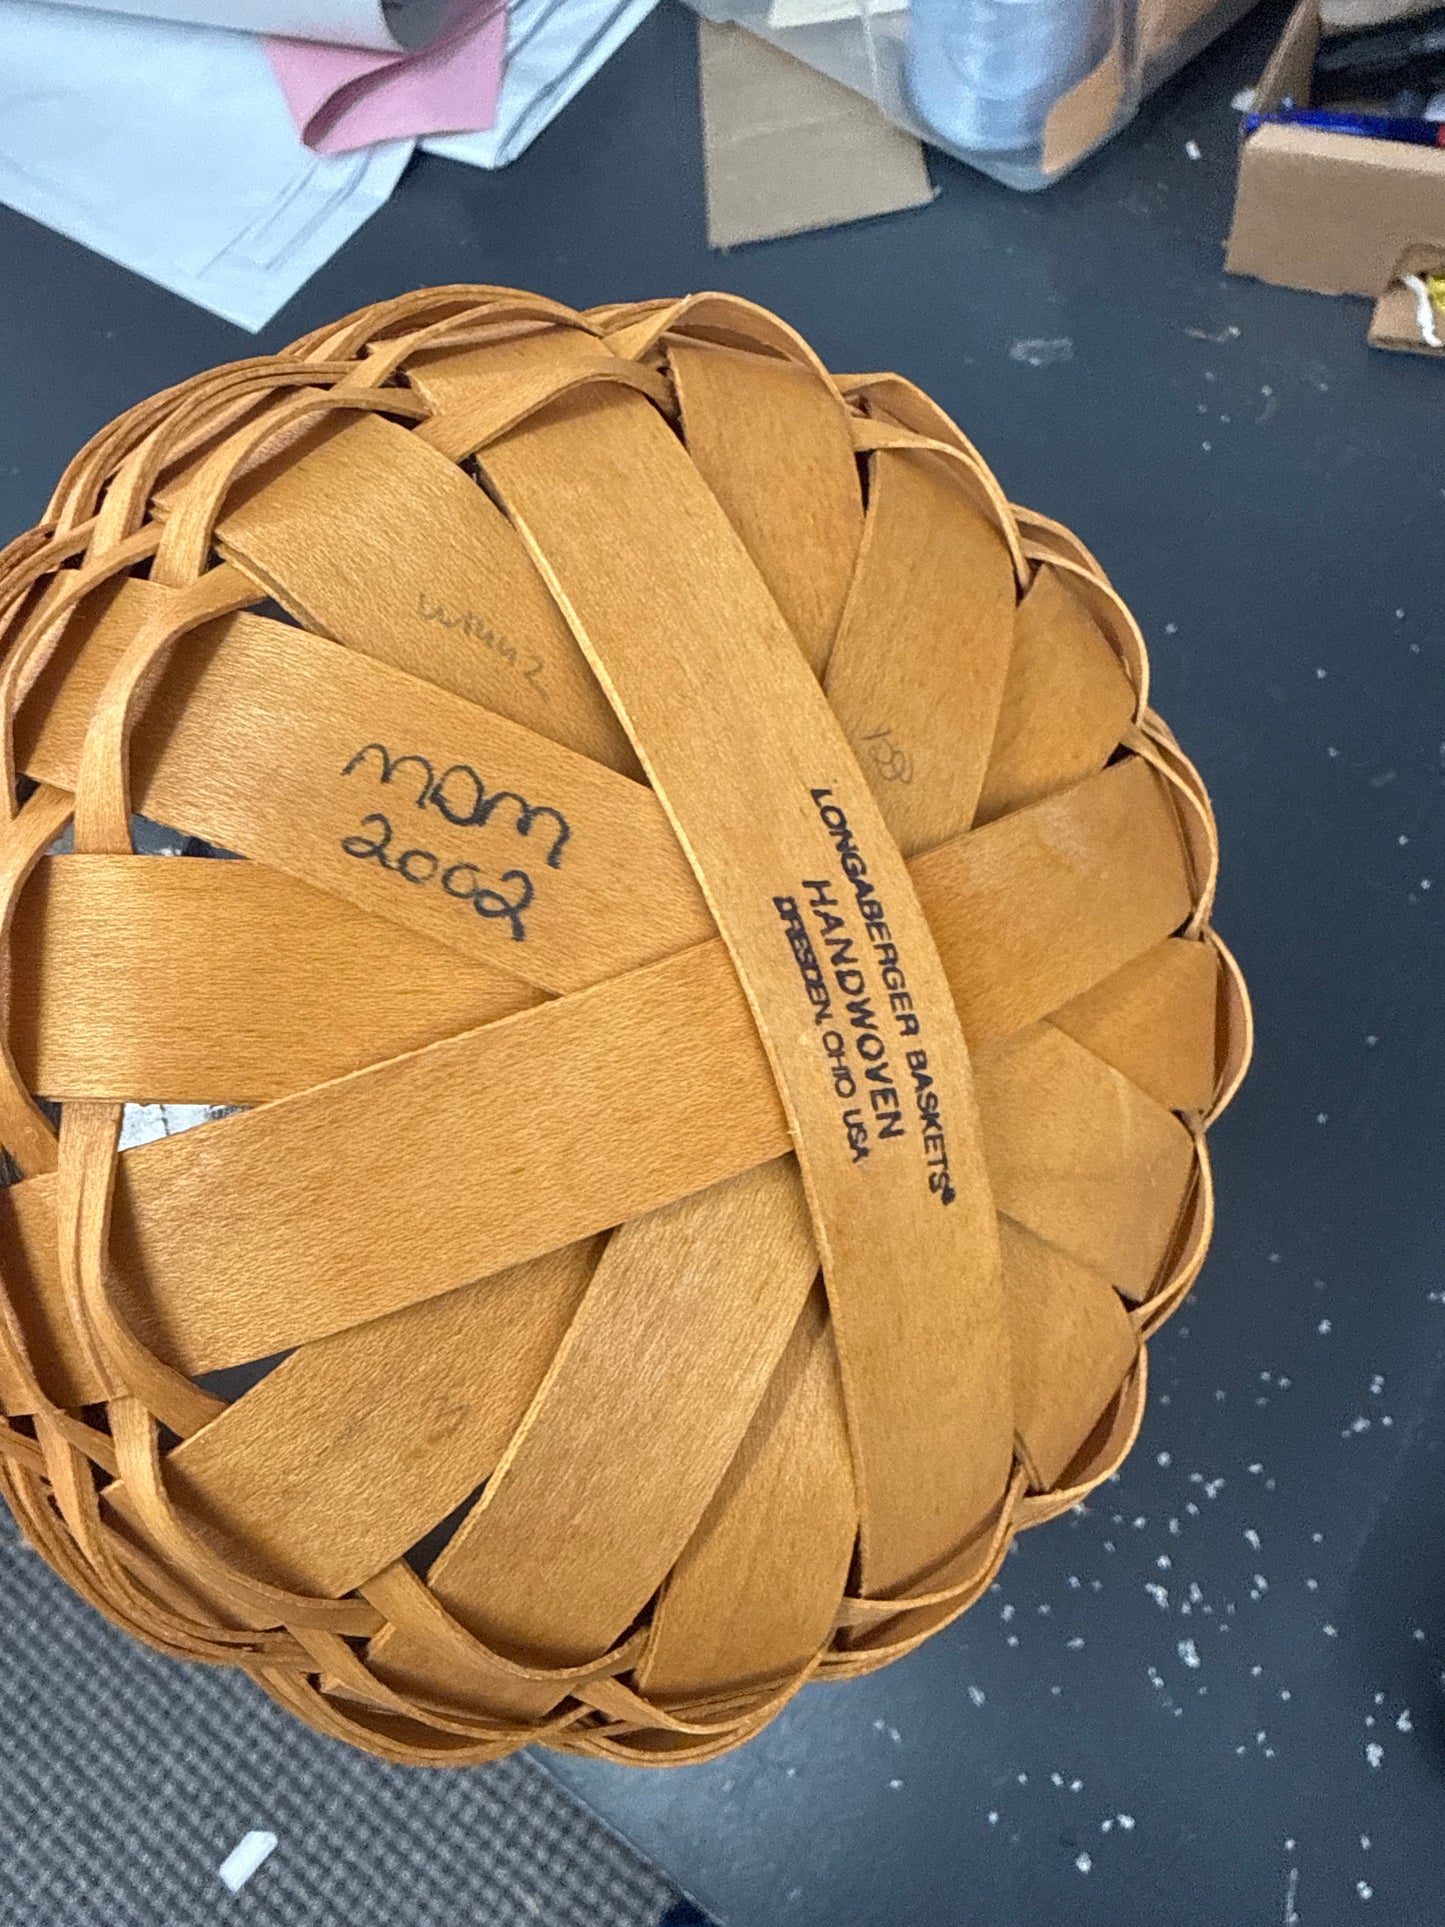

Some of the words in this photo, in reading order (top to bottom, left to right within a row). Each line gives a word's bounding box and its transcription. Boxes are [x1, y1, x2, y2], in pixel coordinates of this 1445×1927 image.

[341, 813, 534, 942] 2002
[810, 787, 920, 1037] LONGABERGER
[803, 880, 904, 1140] HANDWOVEN
[822, 1031, 857, 1099] OHIO
[841, 1109, 869, 1164] USA
